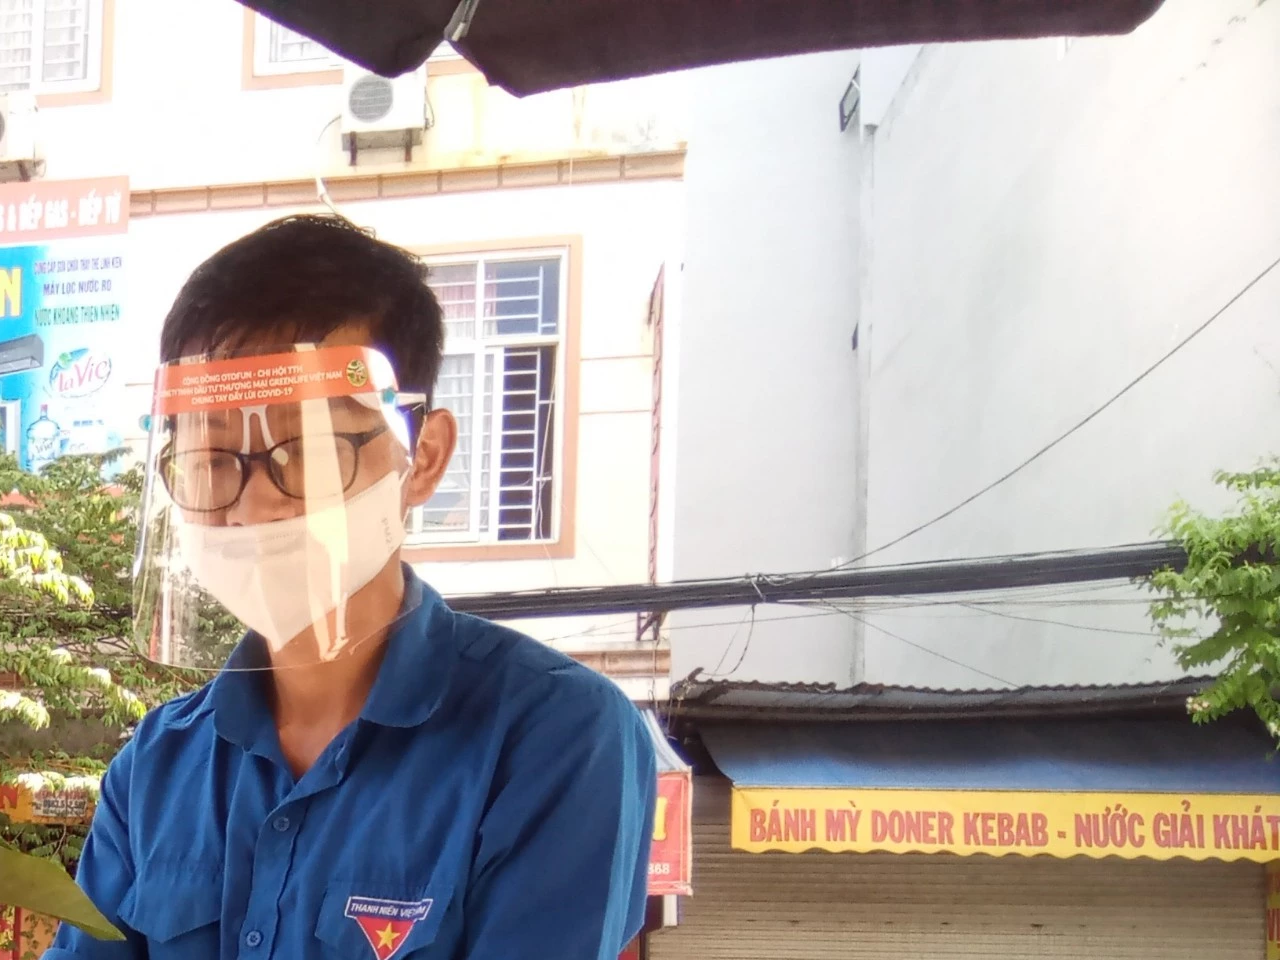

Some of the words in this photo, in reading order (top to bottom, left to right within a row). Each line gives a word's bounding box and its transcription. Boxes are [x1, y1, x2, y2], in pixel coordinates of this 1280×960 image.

[43, 280, 60, 296] MÁY
[78, 278, 99, 294] NƯỚC
[214, 393, 228, 403] TAY
[257, 386, 294, 398] COVID-19
[749, 799, 817, 843] BÁNH
[824, 799, 862, 843] MỲ
[870, 809, 955, 845] DONER
[963, 811, 1049, 847] KEBAB
[1074, 803, 1145, 848] NƯỚC
[1152, 799, 1206, 849] GIẢI
[1212, 804, 1280, 850] KHÁT
[350, 902, 379, 914] THANH
